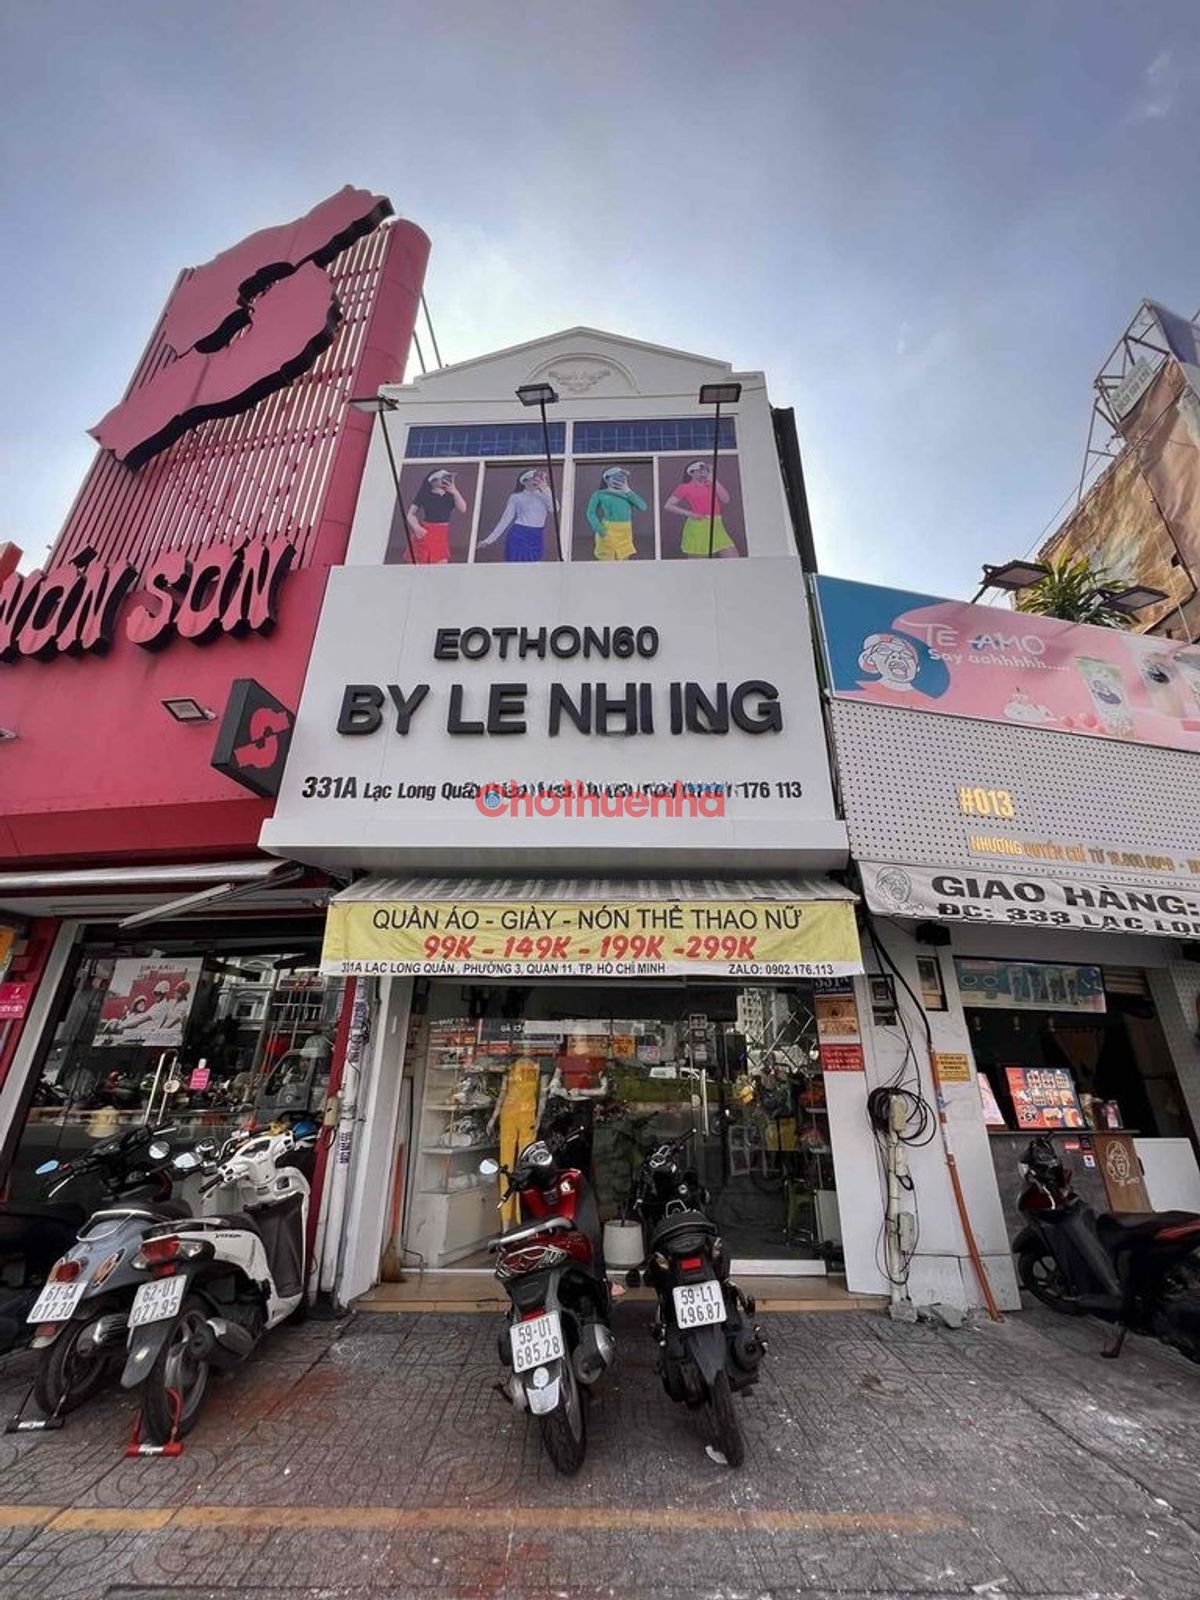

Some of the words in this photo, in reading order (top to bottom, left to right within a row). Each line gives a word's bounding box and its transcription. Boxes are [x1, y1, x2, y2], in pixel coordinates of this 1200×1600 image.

[433, 625, 659, 660] EOTHON60
[928, 649, 962, 664] Say
[336, 684, 431, 735] BY
[447, 683, 528, 735] LE
[548, 682, 655, 737] NHI
[669, 680, 783, 735] ING
[301, 776, 357, 799] 331A
[363, 782, 391, 801] Lạc
[397, 782, 435, 801] Long
[776, 782, 803, 799] 113
[958, 786, 1014, 818] #013
[931, 876, 1046, 903] GIAO
[1062, 885, 1199, 916] HÀNG:
[373, 906, 439, 930] QUẦN
[445, 907, 479, 930] ÁO
[501, 907, 557, 930] GIÀY
[578, 906, 630, 929] NÓN
[637, 905, 684, 929] THỂ
[690, 909, 757, 929] THAO
[765, 906, 802, 929] NỮ
[937, 902, 994, 918] ĐC:
[1006, 907, 1070, 924] 333
[423, 934, 476, 959] 99K
[503, 935, 572, 959] 149K
[599, 935, 665, 959] 199K
[365, 962, 387, 974] LẠC
[390, 962, 420, 973] LONG
[580, 963, 593, 974] TP.
[638, 962, 666, 974] MINH
[728, 964, 763, 975] ZALO:
[766, 964, 834, 976] 0902.176.113
[680, 1285, 715, 1306] 59-L1
[132, 1298, 178, 1323] 027.95
[680, 1302, 722, 1325] 496.87
[518, 1320, 553, 1345] 59-U1
[516, 1336, 561, 1368] 685.28
